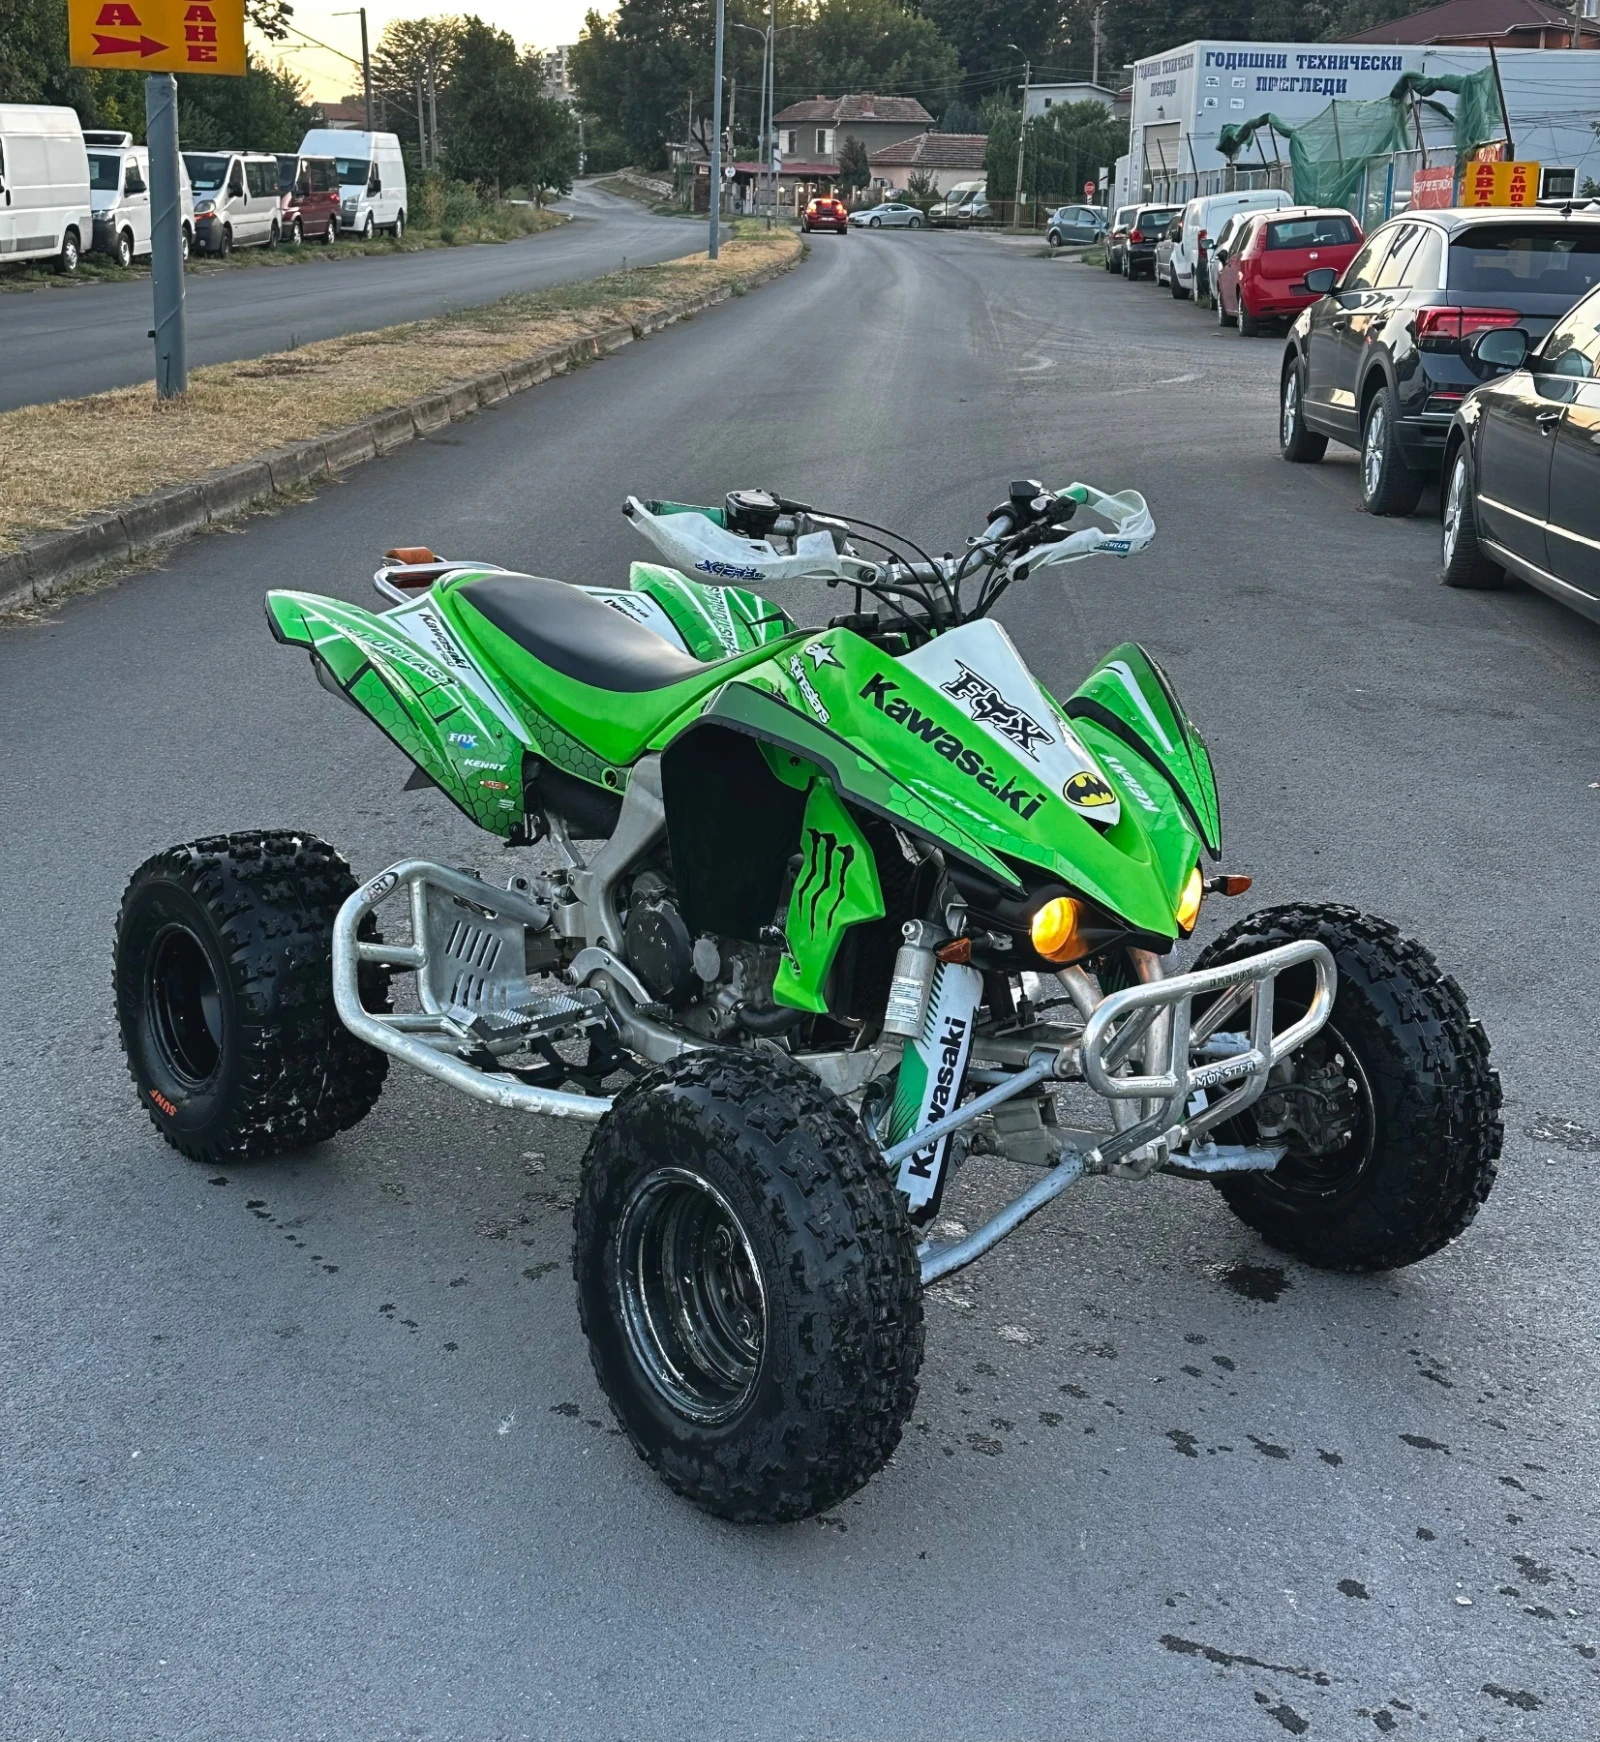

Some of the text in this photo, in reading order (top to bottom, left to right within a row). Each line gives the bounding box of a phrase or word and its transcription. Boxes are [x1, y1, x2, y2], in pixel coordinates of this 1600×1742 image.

[183, 0, 218, 62] АНЕ
[1205, 51, 1403, 71] ГОДИШНИ ТЕХНИЧЕСКИ
[1256, 76, 1348, 96] ПРЕГЛЕДИ
[418, 613, 472, 670] Kawasaki
[939, 659, 1056, 763] FOX
[448, 733, 479, 747] FOX
[858, 672, 1048, 821] Kawasaki
[464, 758, 507, 771] KENNY
[1195, 1061, 1255, 1087] MONSTER
[149, 1088, 177, 1117] SUNF
